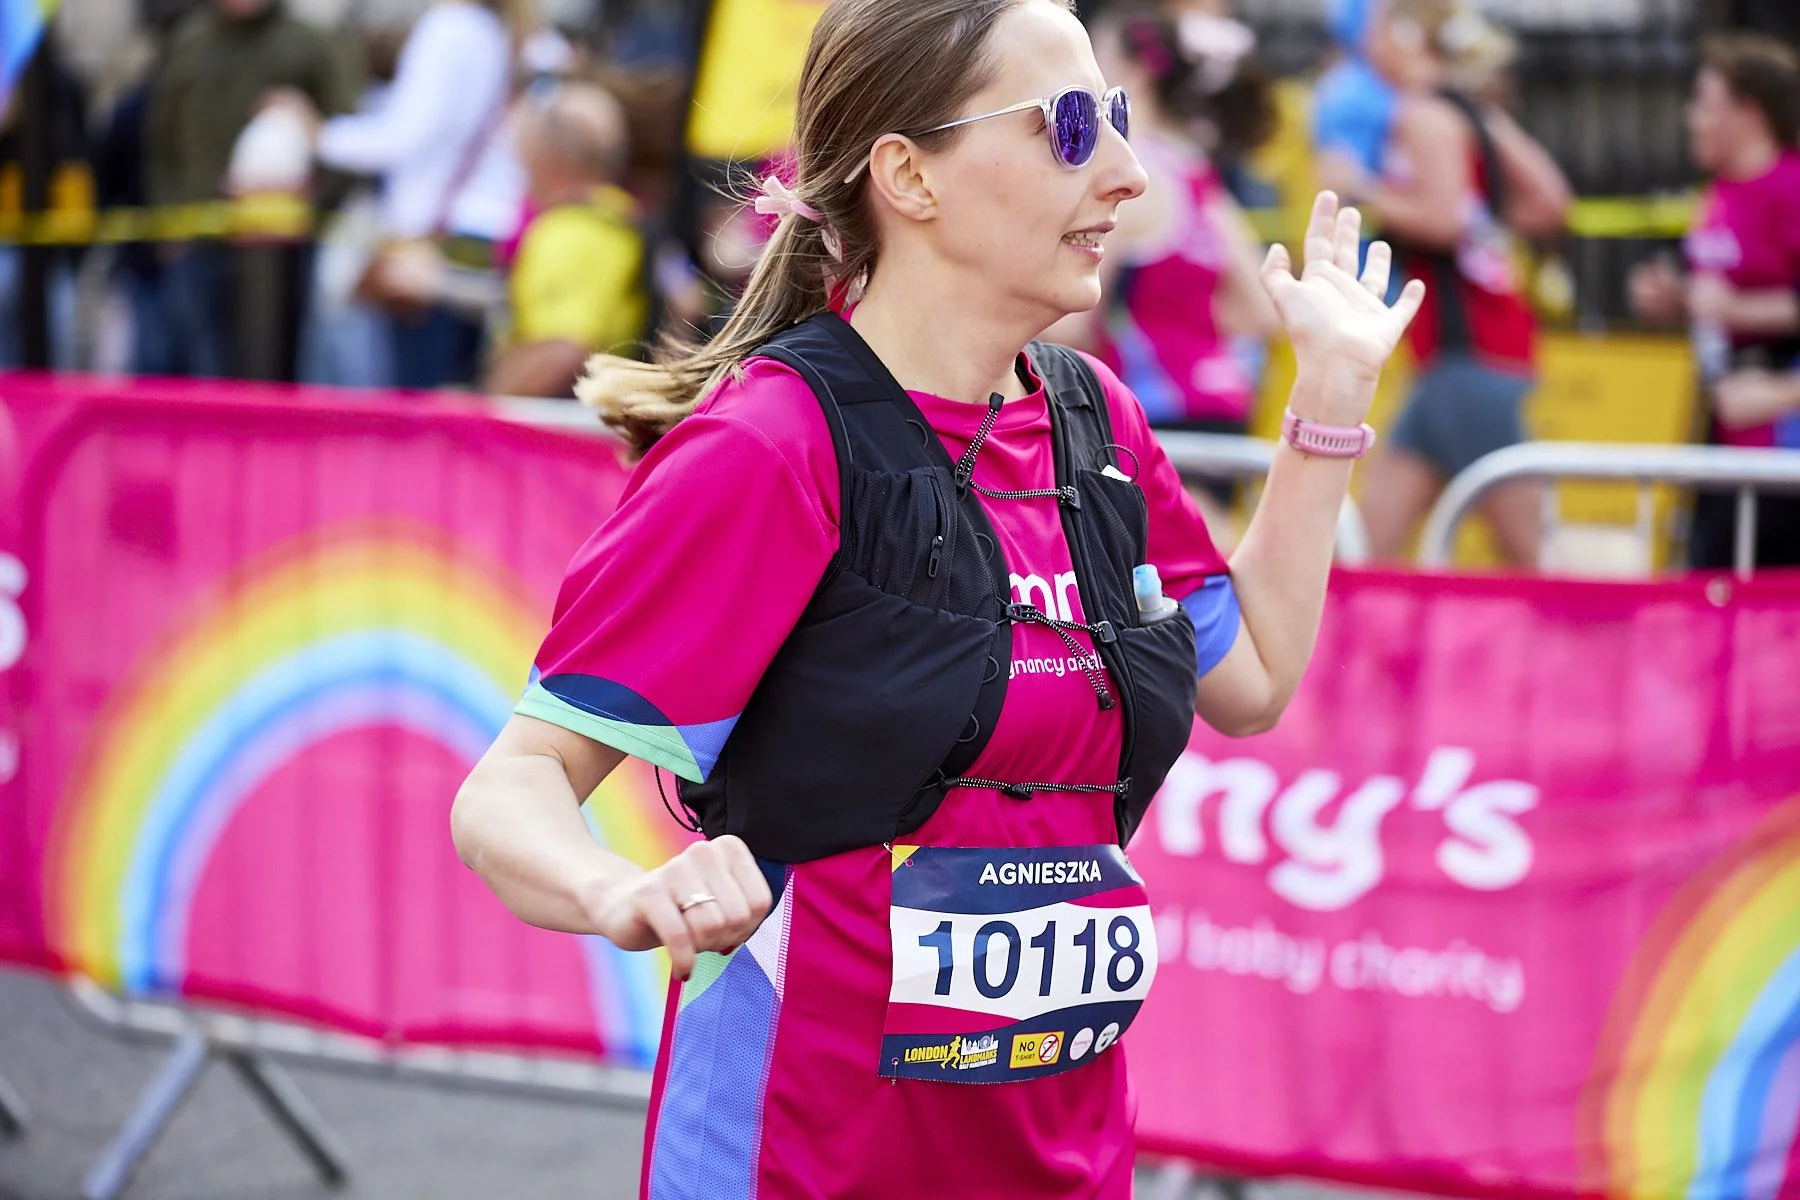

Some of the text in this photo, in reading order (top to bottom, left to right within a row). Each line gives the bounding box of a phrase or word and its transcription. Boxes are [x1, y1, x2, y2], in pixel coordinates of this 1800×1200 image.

[1008, 656, 1066, 680] gnancy
[1128, 745, 1541, 912] my's
[978, 860, 1102, 885] AGNIESZKA
[917, 915, 1145, 1000] 10118
[1186, 907, 1325, 994] baby
[904, 1045, 949, 1062] LONDON
[960, 1049, 998, 1064] LANDMARKS
[1015, 1053, 1036, 1061] T-SHIRT
[1019, 1041, 1035, 1052] NO
